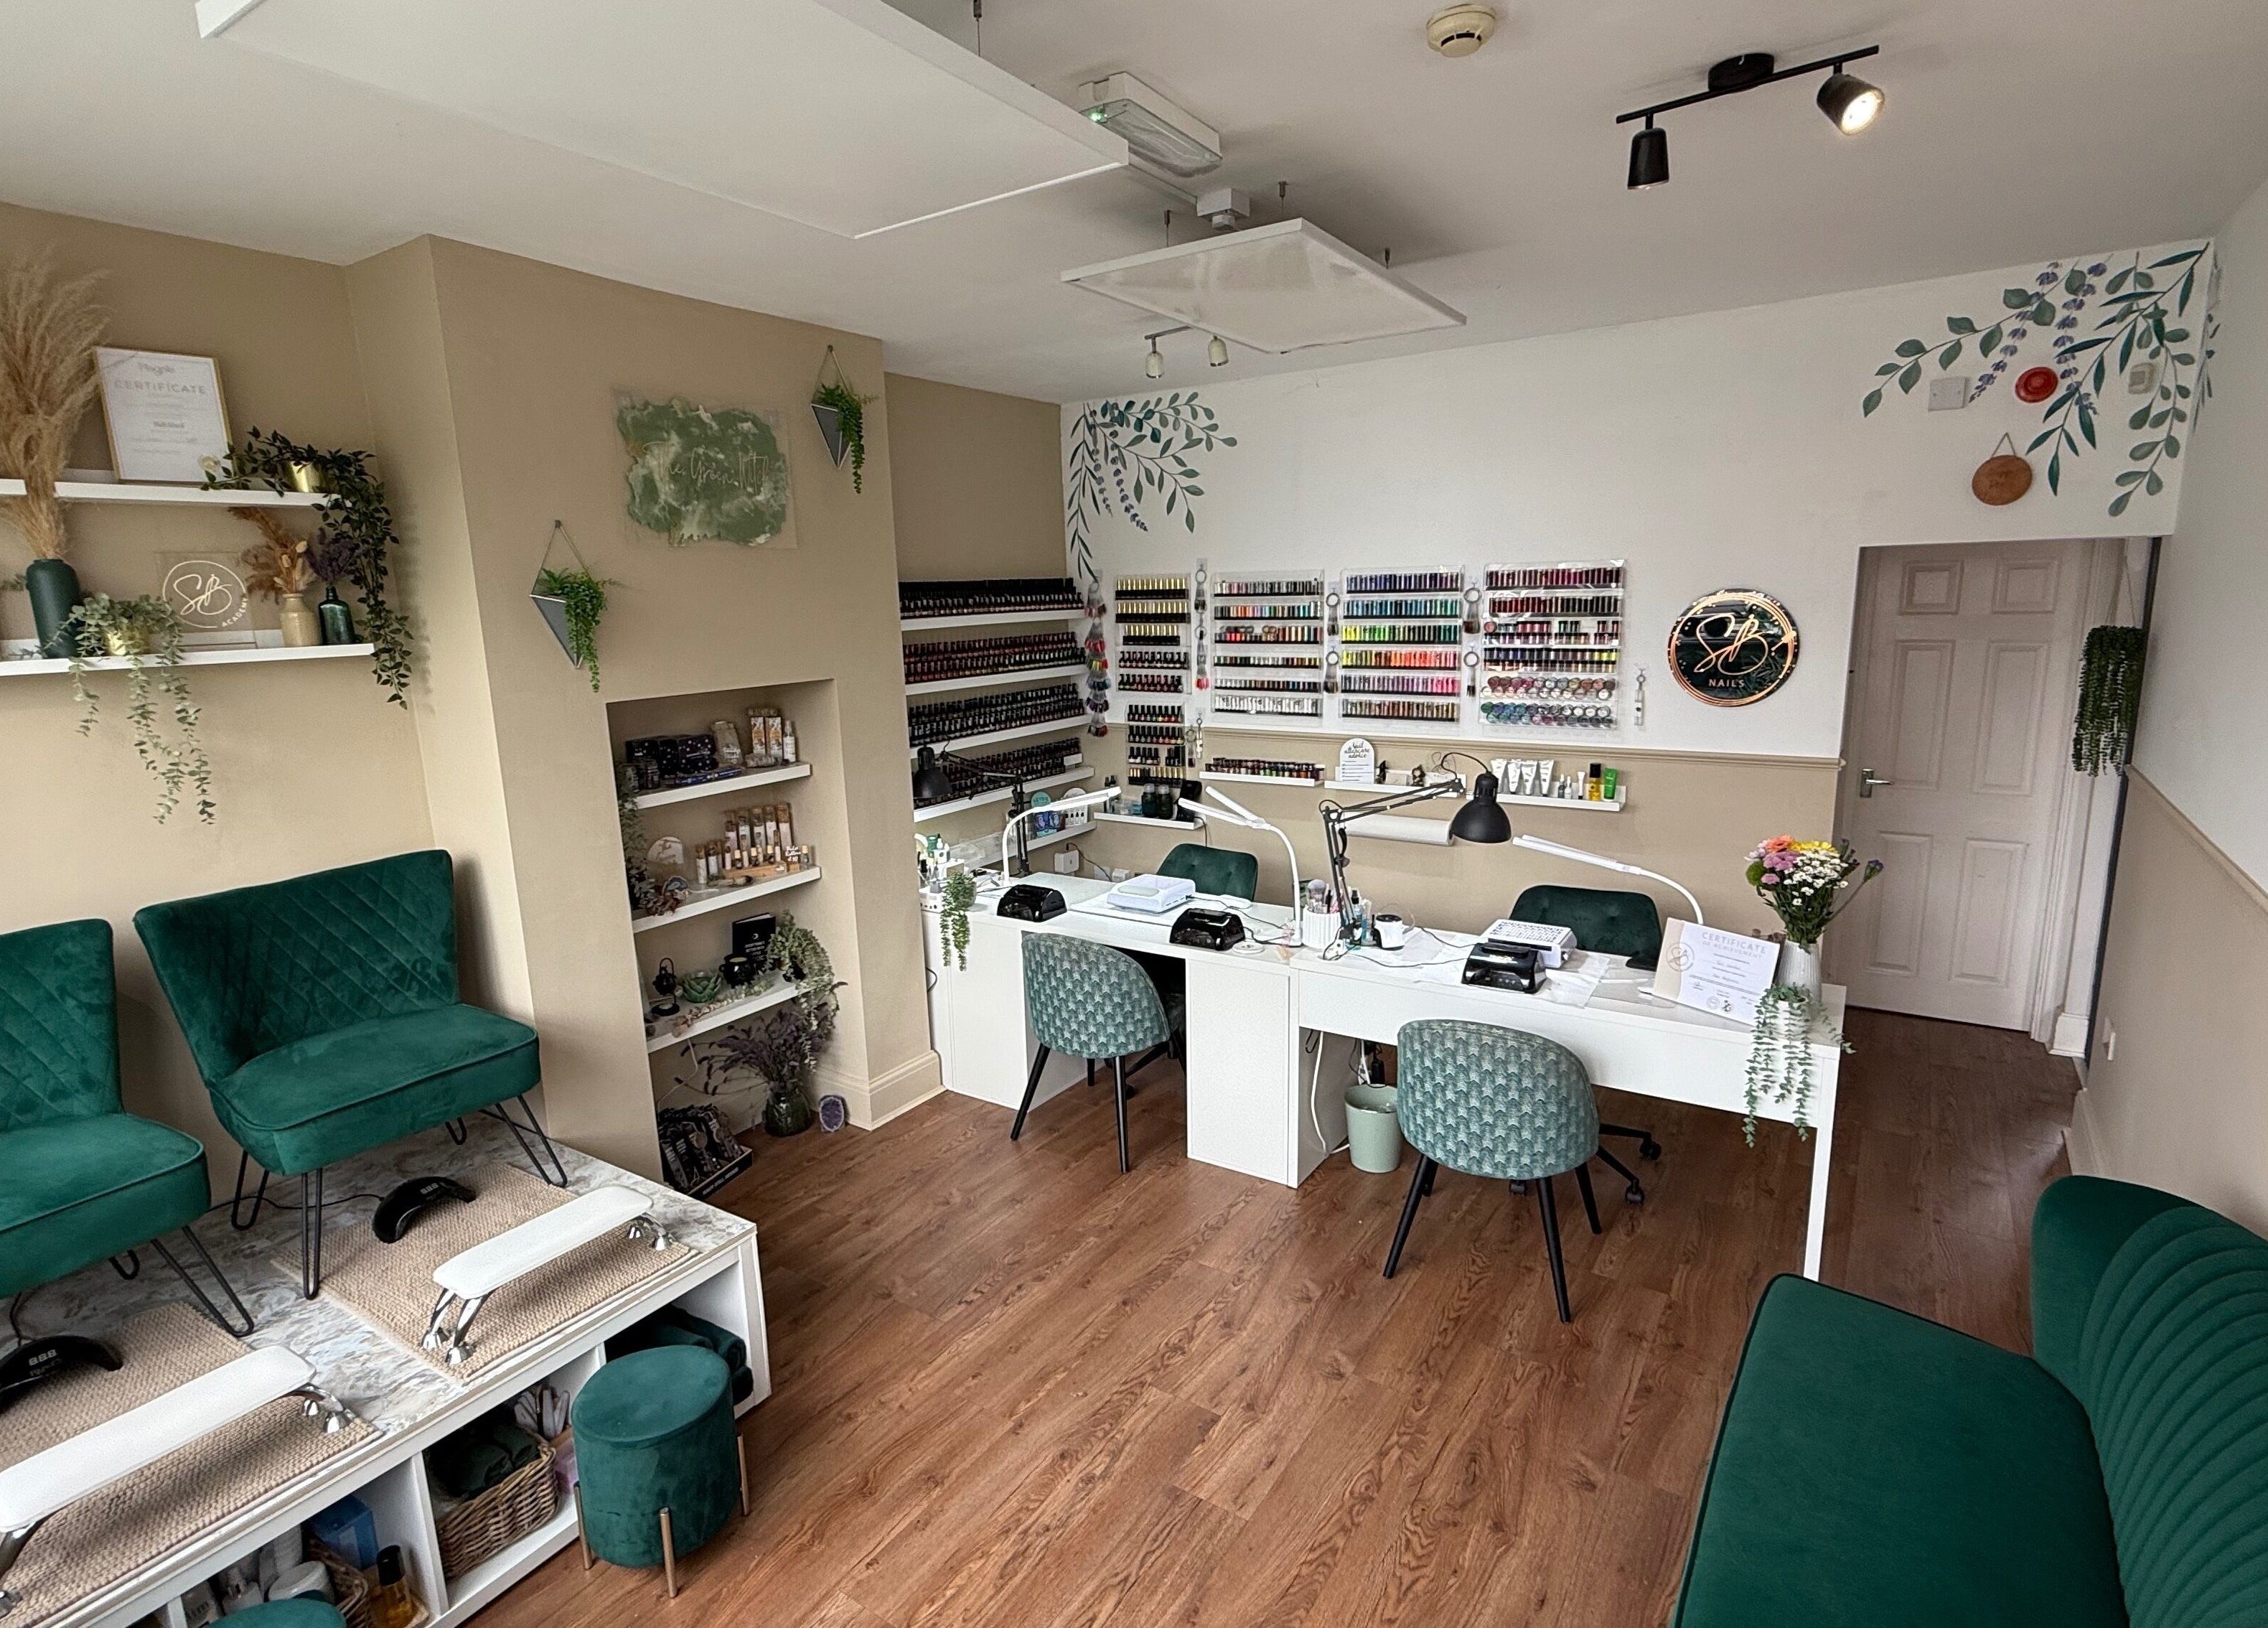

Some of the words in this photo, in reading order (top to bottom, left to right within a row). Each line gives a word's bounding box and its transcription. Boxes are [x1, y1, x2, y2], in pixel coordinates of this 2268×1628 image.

[115, 380, 206, 394] CERTIFICATE
[221, 597, 249, 627] ACADEMY
[1708, 678, 1745, 688] NAILS
[1702, 932, 1767, 954] CERTIFICATE
